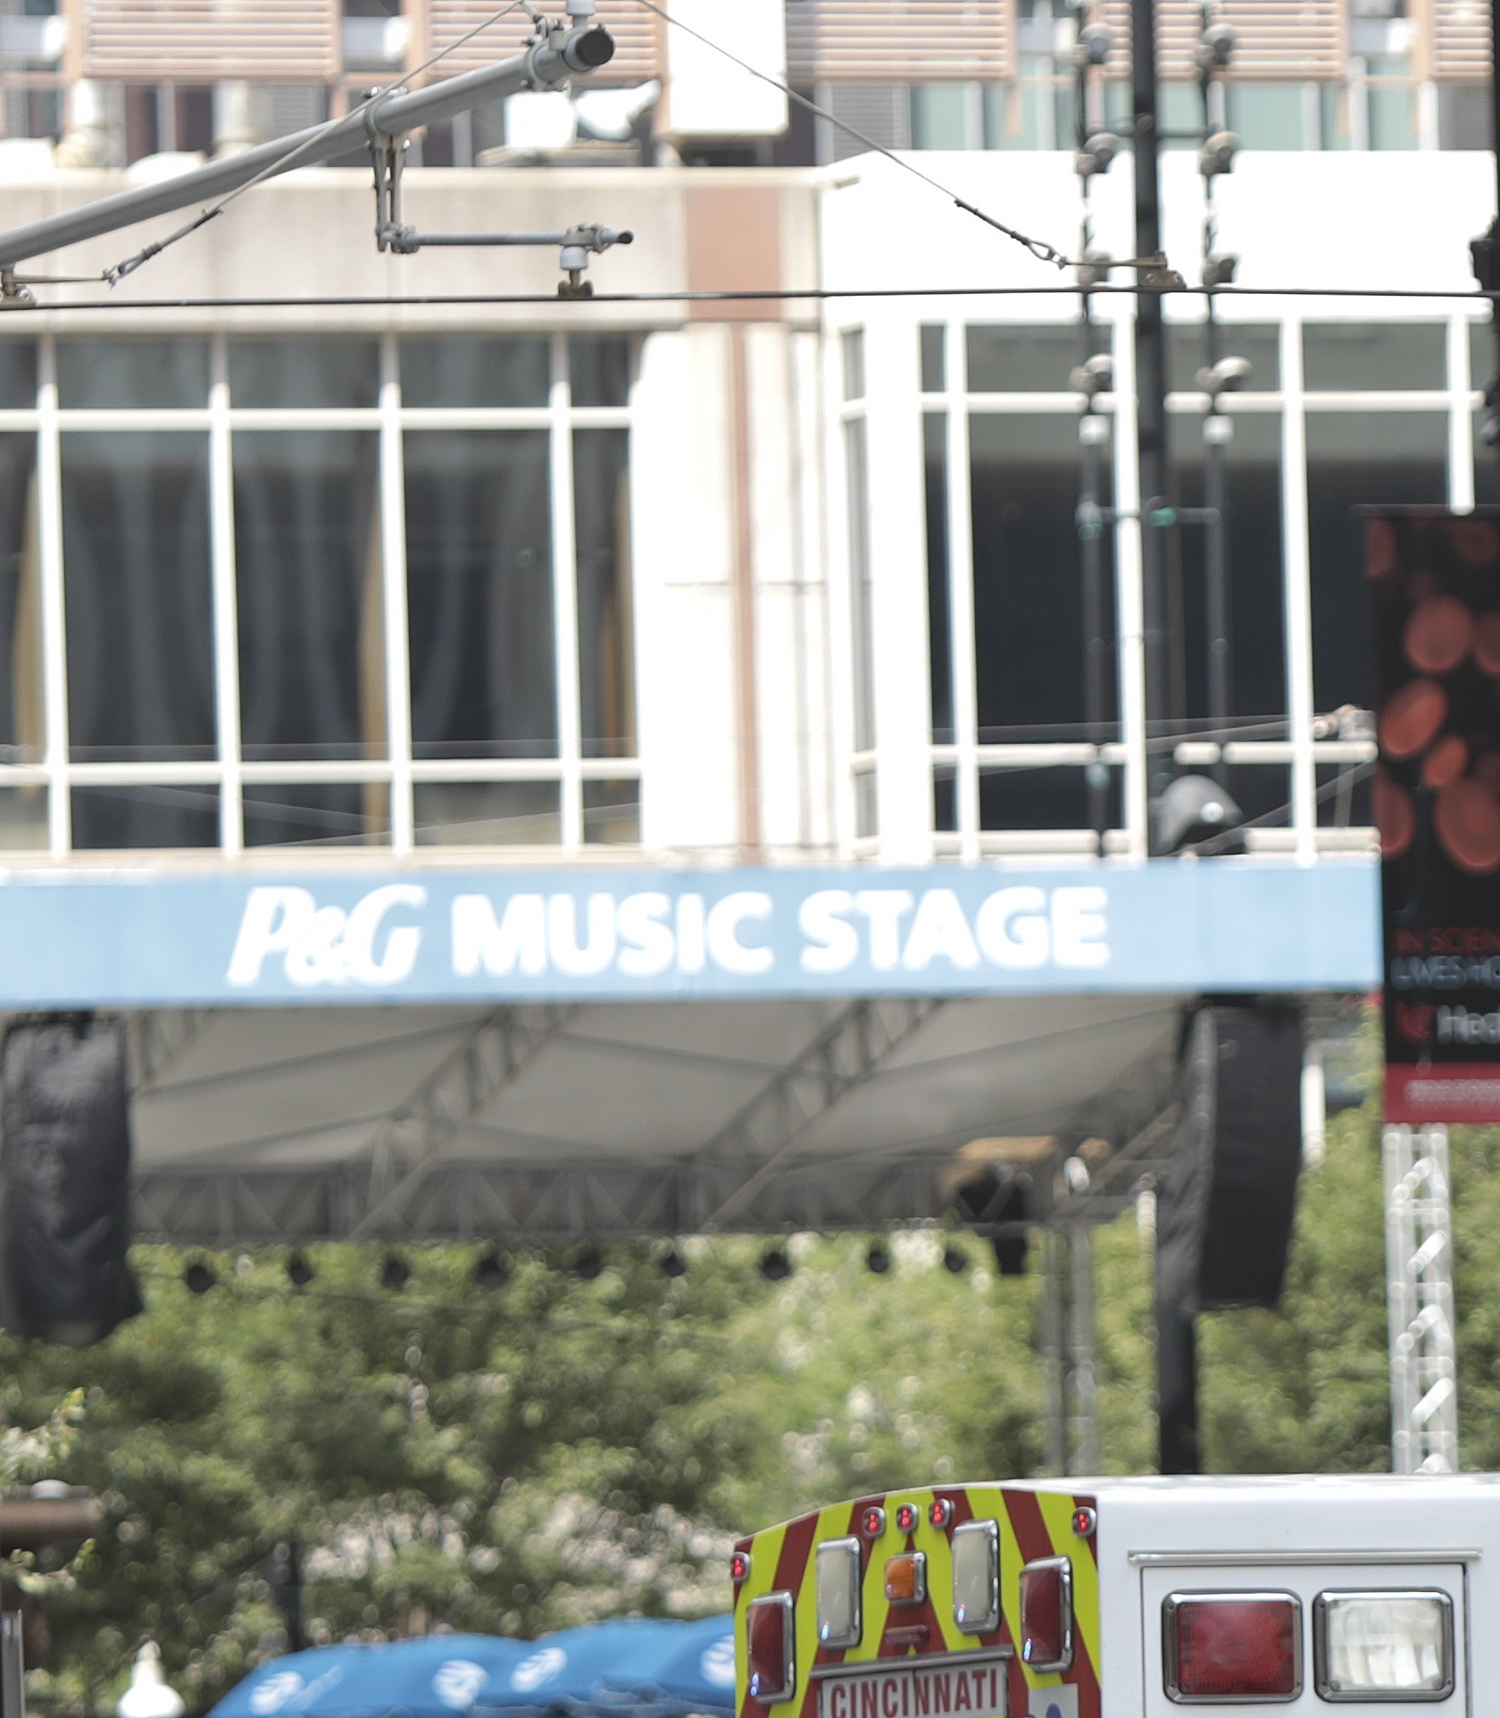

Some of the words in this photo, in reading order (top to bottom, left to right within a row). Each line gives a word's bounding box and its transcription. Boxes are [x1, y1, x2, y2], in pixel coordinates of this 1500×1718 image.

[227, 884, 428, 986] P&G
[451, 890, 776, 978] MUSIC
[798, 887, 1111, 974] STAGE
